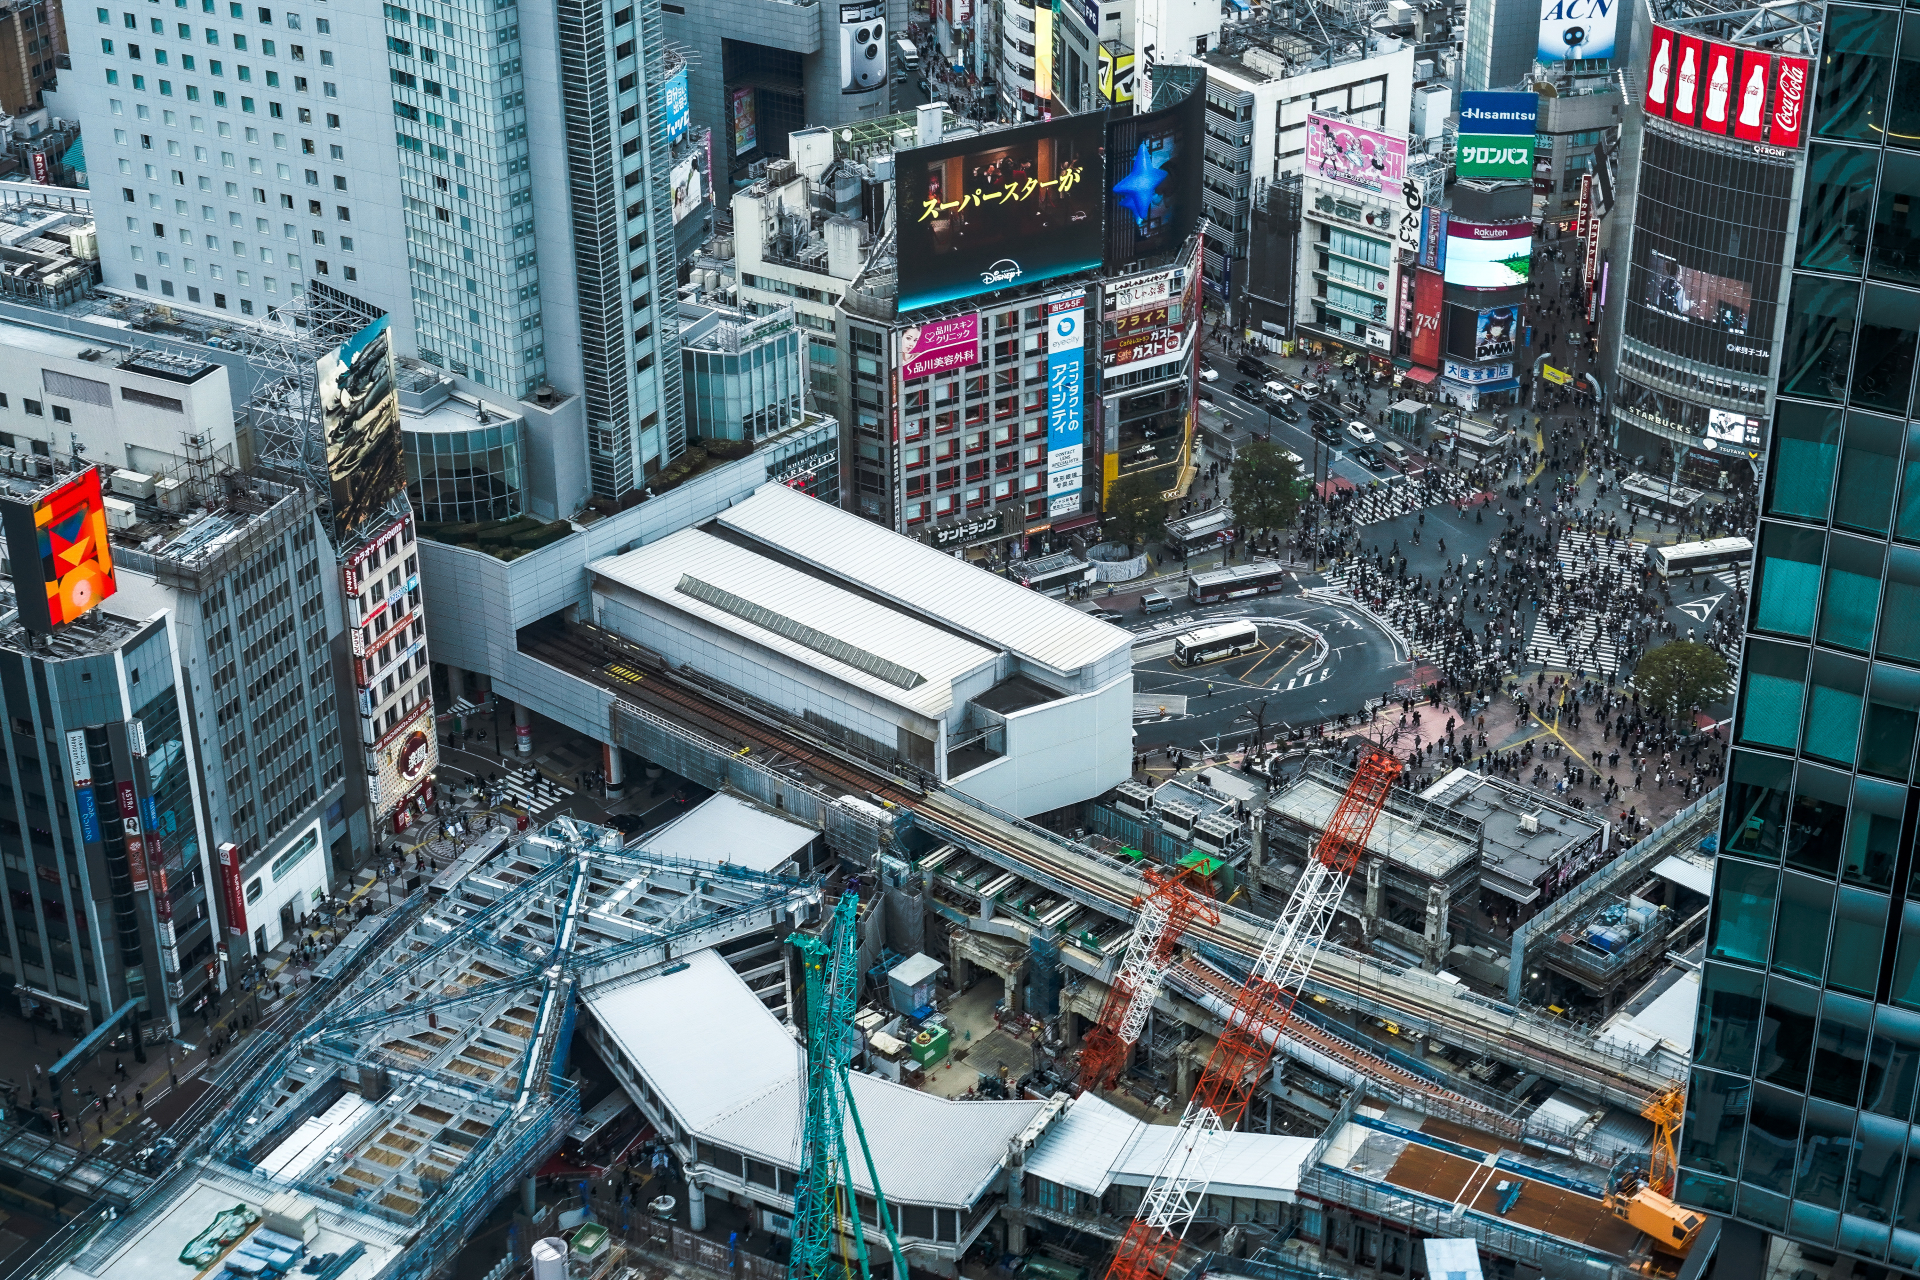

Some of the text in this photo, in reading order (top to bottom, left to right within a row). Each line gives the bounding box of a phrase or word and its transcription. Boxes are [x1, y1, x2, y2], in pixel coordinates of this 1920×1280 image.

[842, 1, 886, 22] PRO
[1085, 5, 1097, 25] FPG
[1461, 108, 1536, 120] Hisamitsu
[1462, 146, 1529, 165] サロンパス
[35, 155, 45, 182] カラオケ
[918, 167, 1083, 222] スーパースターが
[1399, 179, 1421, 250] もんじゃ
[1474, 228, 1508, 238] Rakuten
[1589, 223, 1598, 255] カラオケ
[1105, 297, 1115, 306] 9F
[936, 319, 974, 335] 品川スキン
[936, 329, 970, 344] クリニック
[1104, 353, 1116, 363] 7F
[1132, 342, 1162, 360] ガスト
[1477, 341, 1513, 358] DMM
[914, 349, 974, 374] 品川美容外科
[1448, 363, 1510, 380] 大盛堂書店
[1052, 363, 1067, 433] アイシティ
[1068, 360, 1079, 431] コンタクトの
[1629, 406, 1691, 434] STARBUCKS
[1720, 446, 1745, 455] TSUTAYA
[938, 517, 997, 543] サンドラッグ
[354, 543, 376, 565] カラオケ
[125, 789, 133, 810] ASTRA
